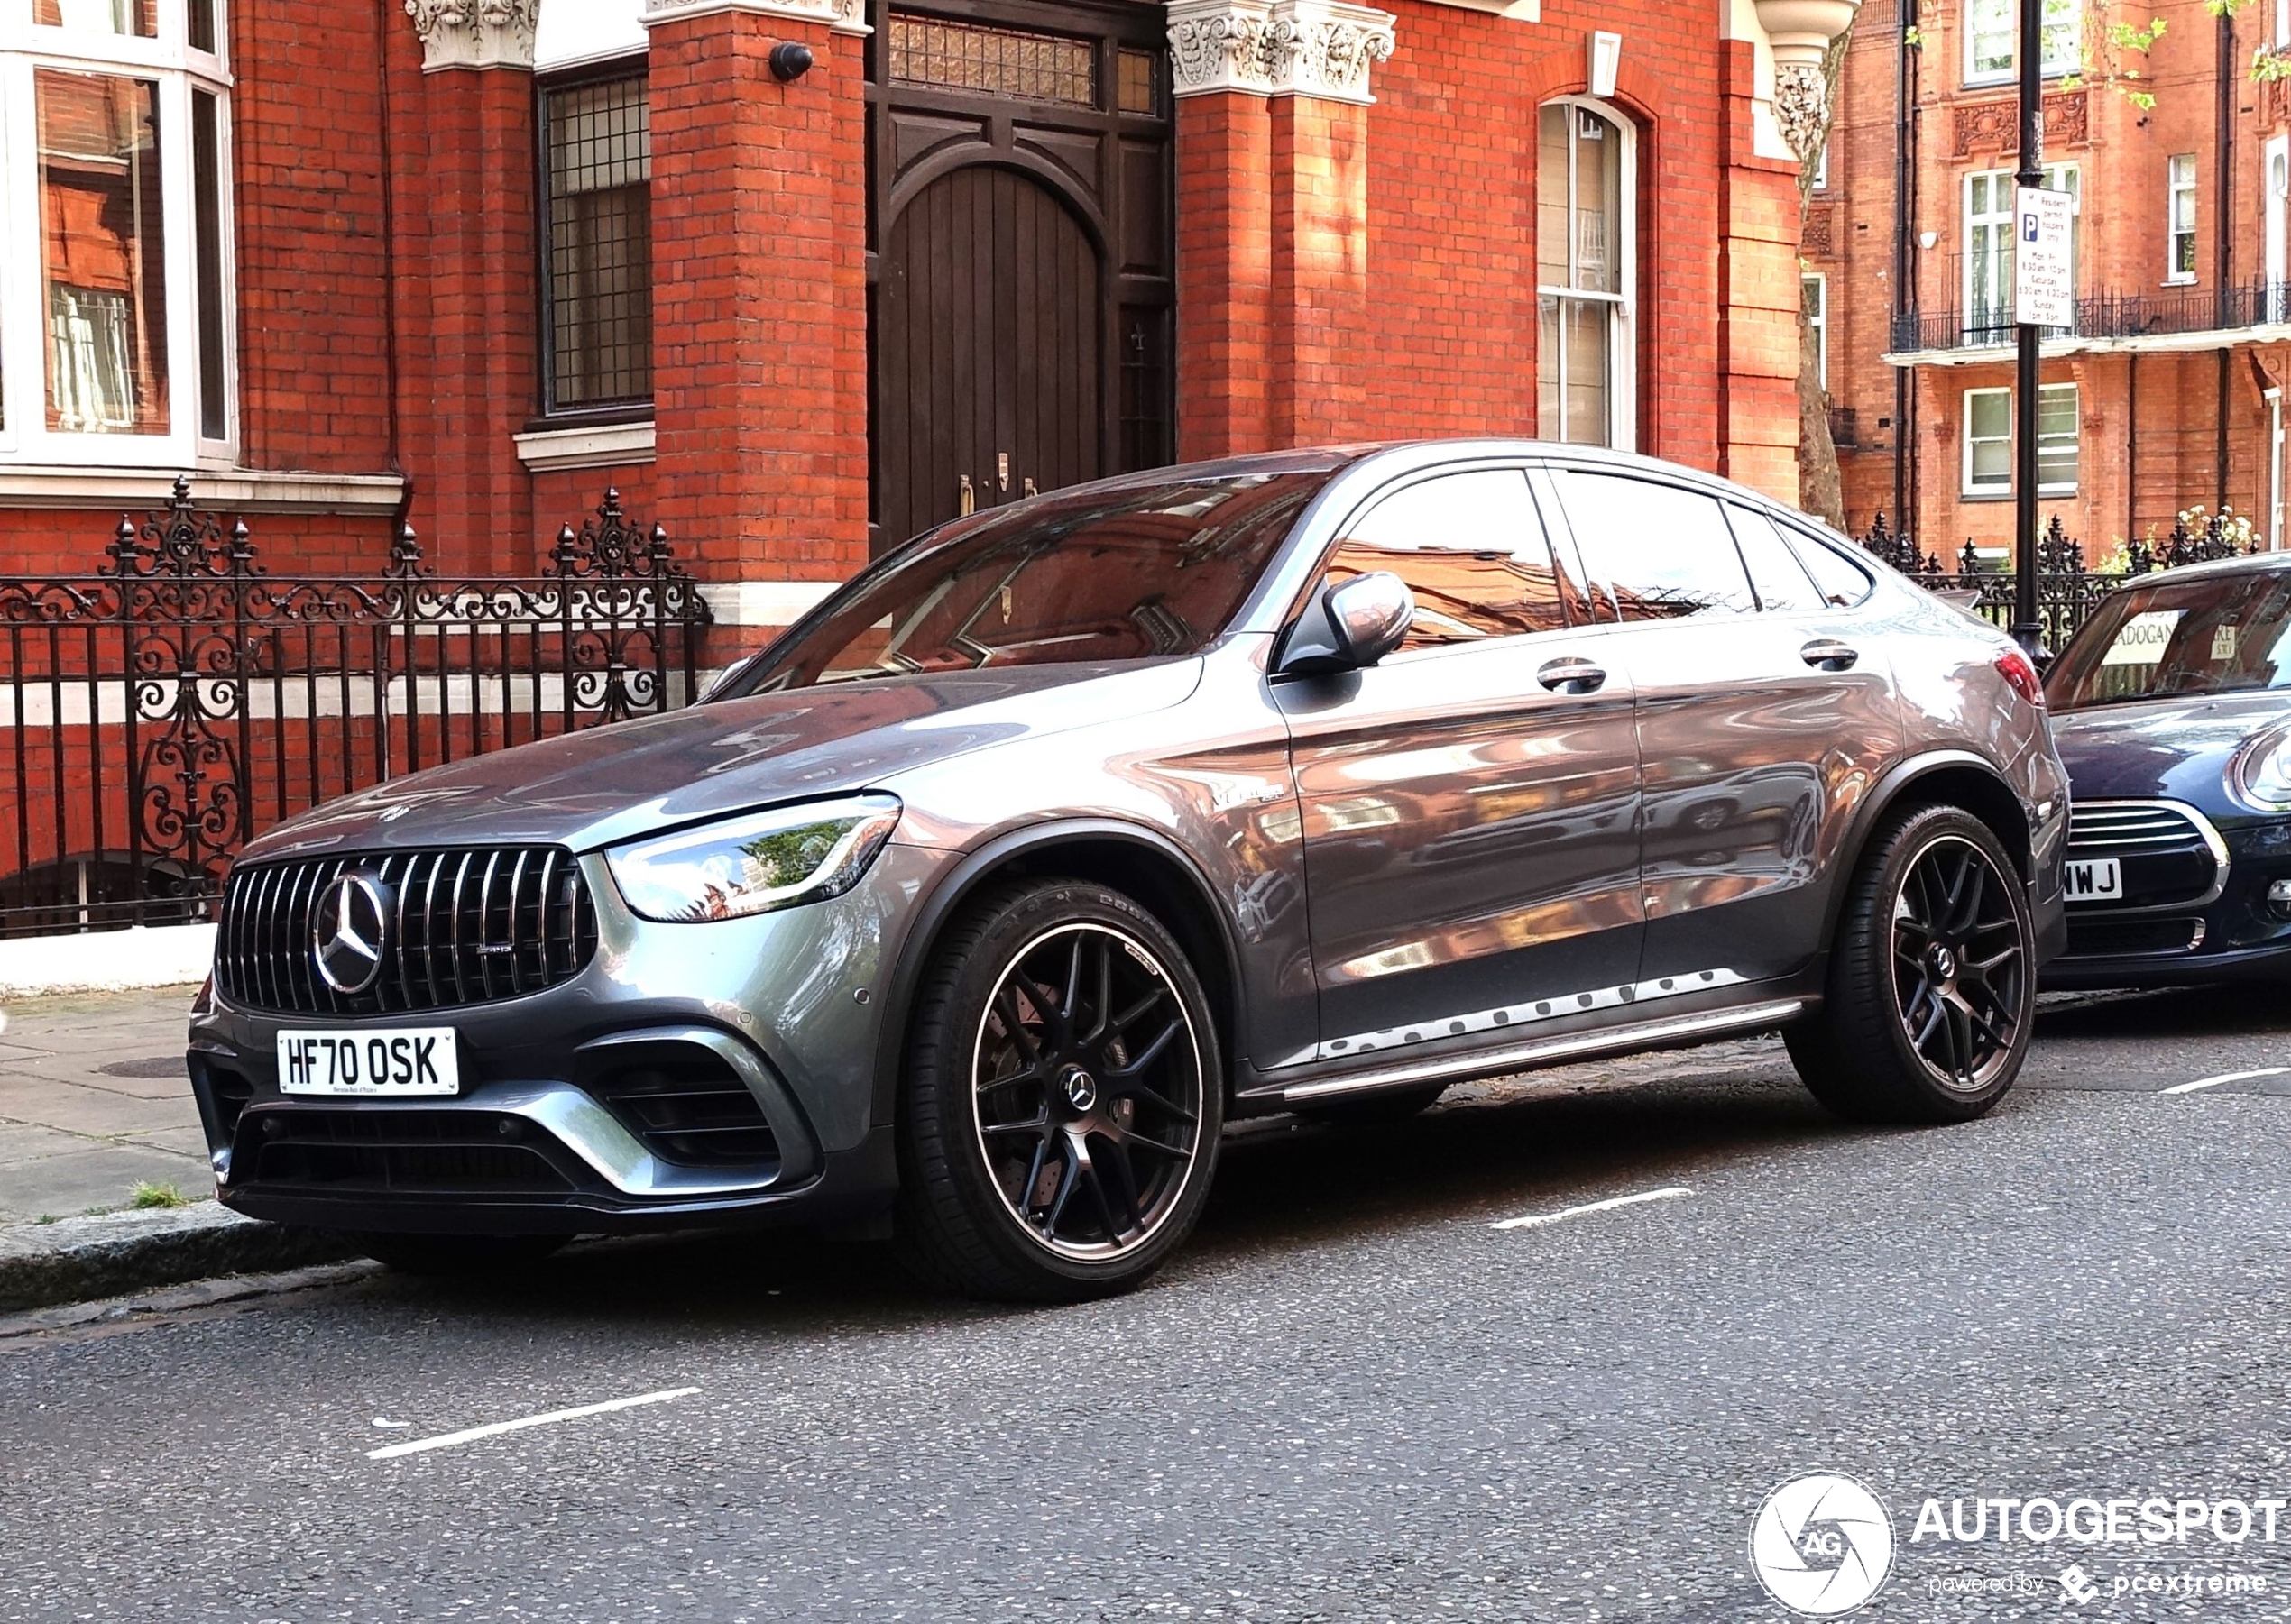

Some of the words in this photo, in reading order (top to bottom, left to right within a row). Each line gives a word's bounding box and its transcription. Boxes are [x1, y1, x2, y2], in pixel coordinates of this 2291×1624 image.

[2026, 216, 2037, 241] P
[288, 1038, 359, 1085] HF70
[368, 1036, 439, 1085] OSK
